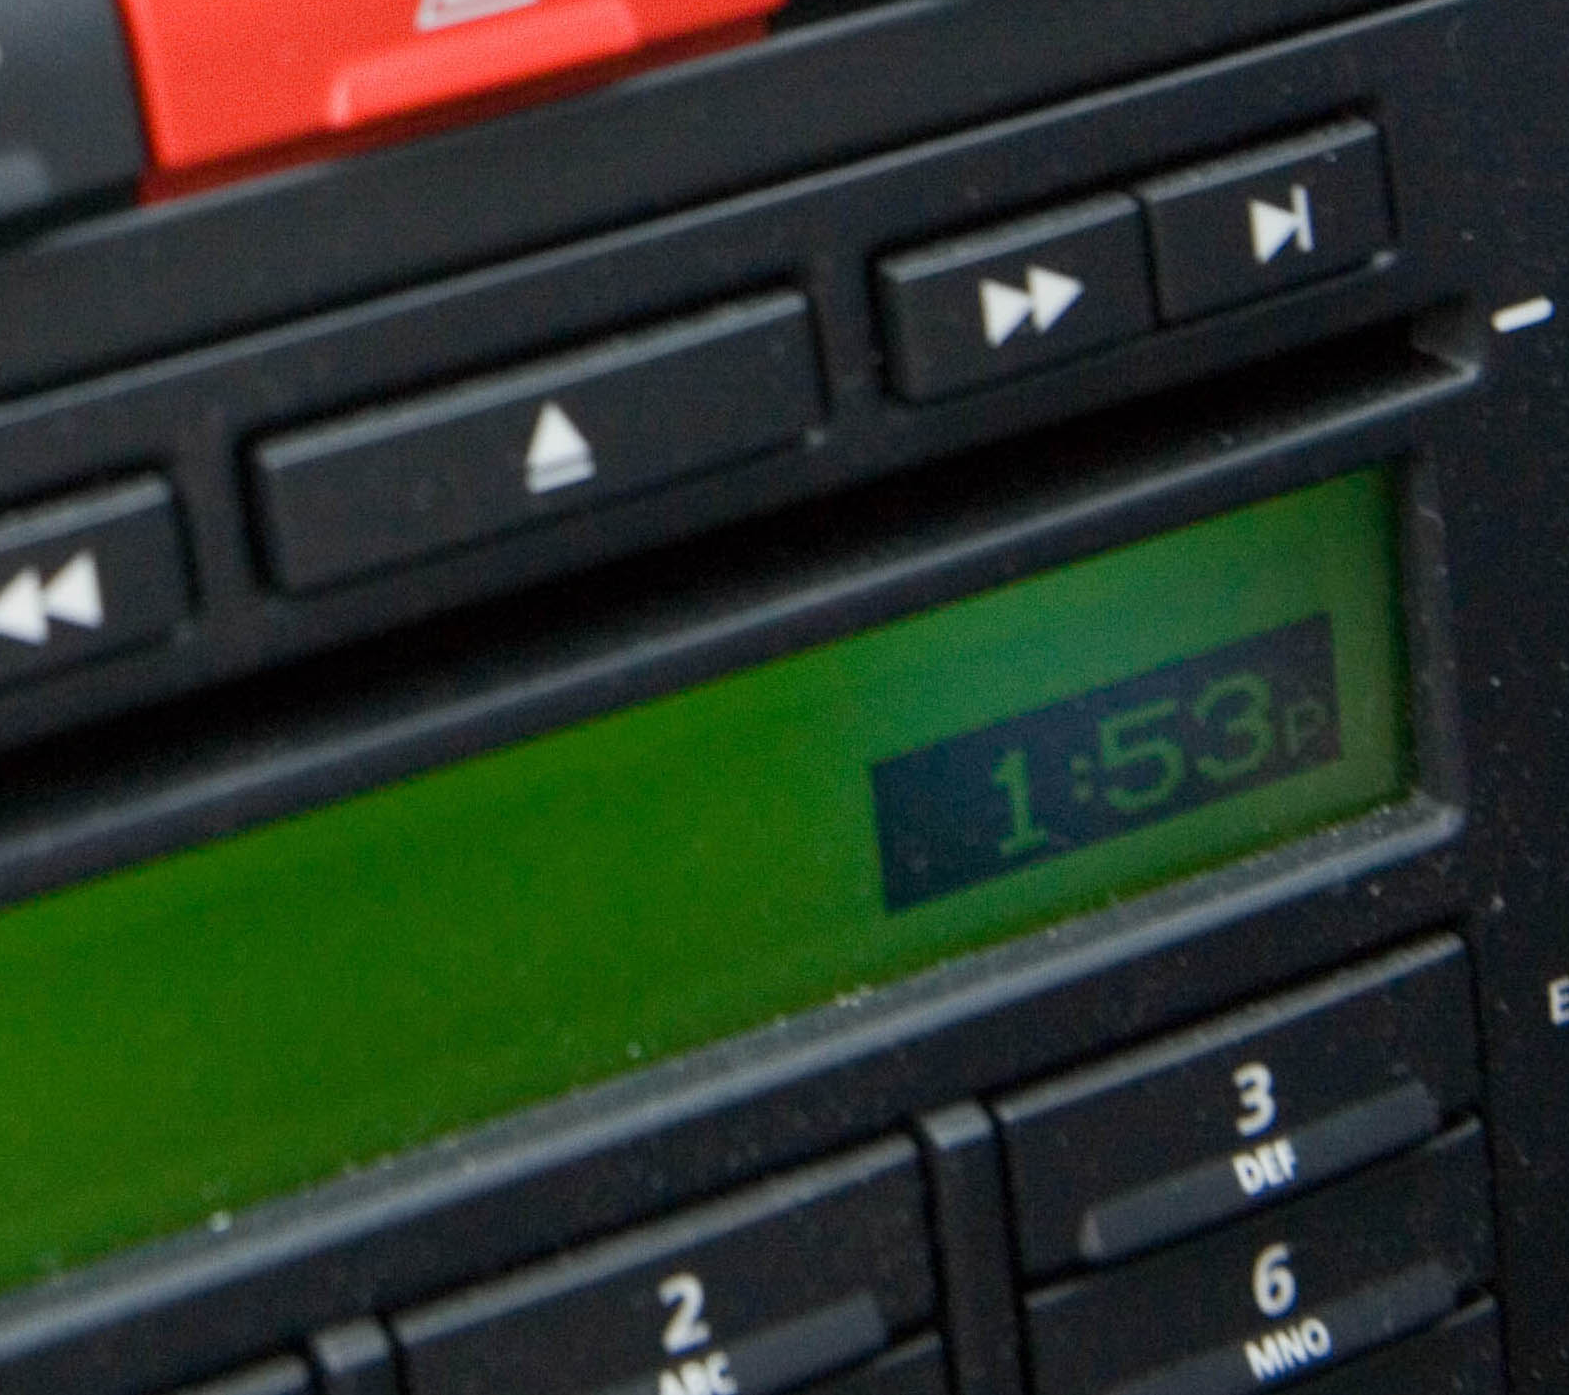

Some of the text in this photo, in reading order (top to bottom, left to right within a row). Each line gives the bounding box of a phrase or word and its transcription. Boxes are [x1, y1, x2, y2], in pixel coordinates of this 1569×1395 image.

[1232, 1062, 1277, 1137] 3
[1232, 1137, 1297, 1196] DEF
[658, 1272, 712, 1353] 2
[1252, 1241, 1296, 1317] 6
[1243, 1317, 1331, 1382] MNO
